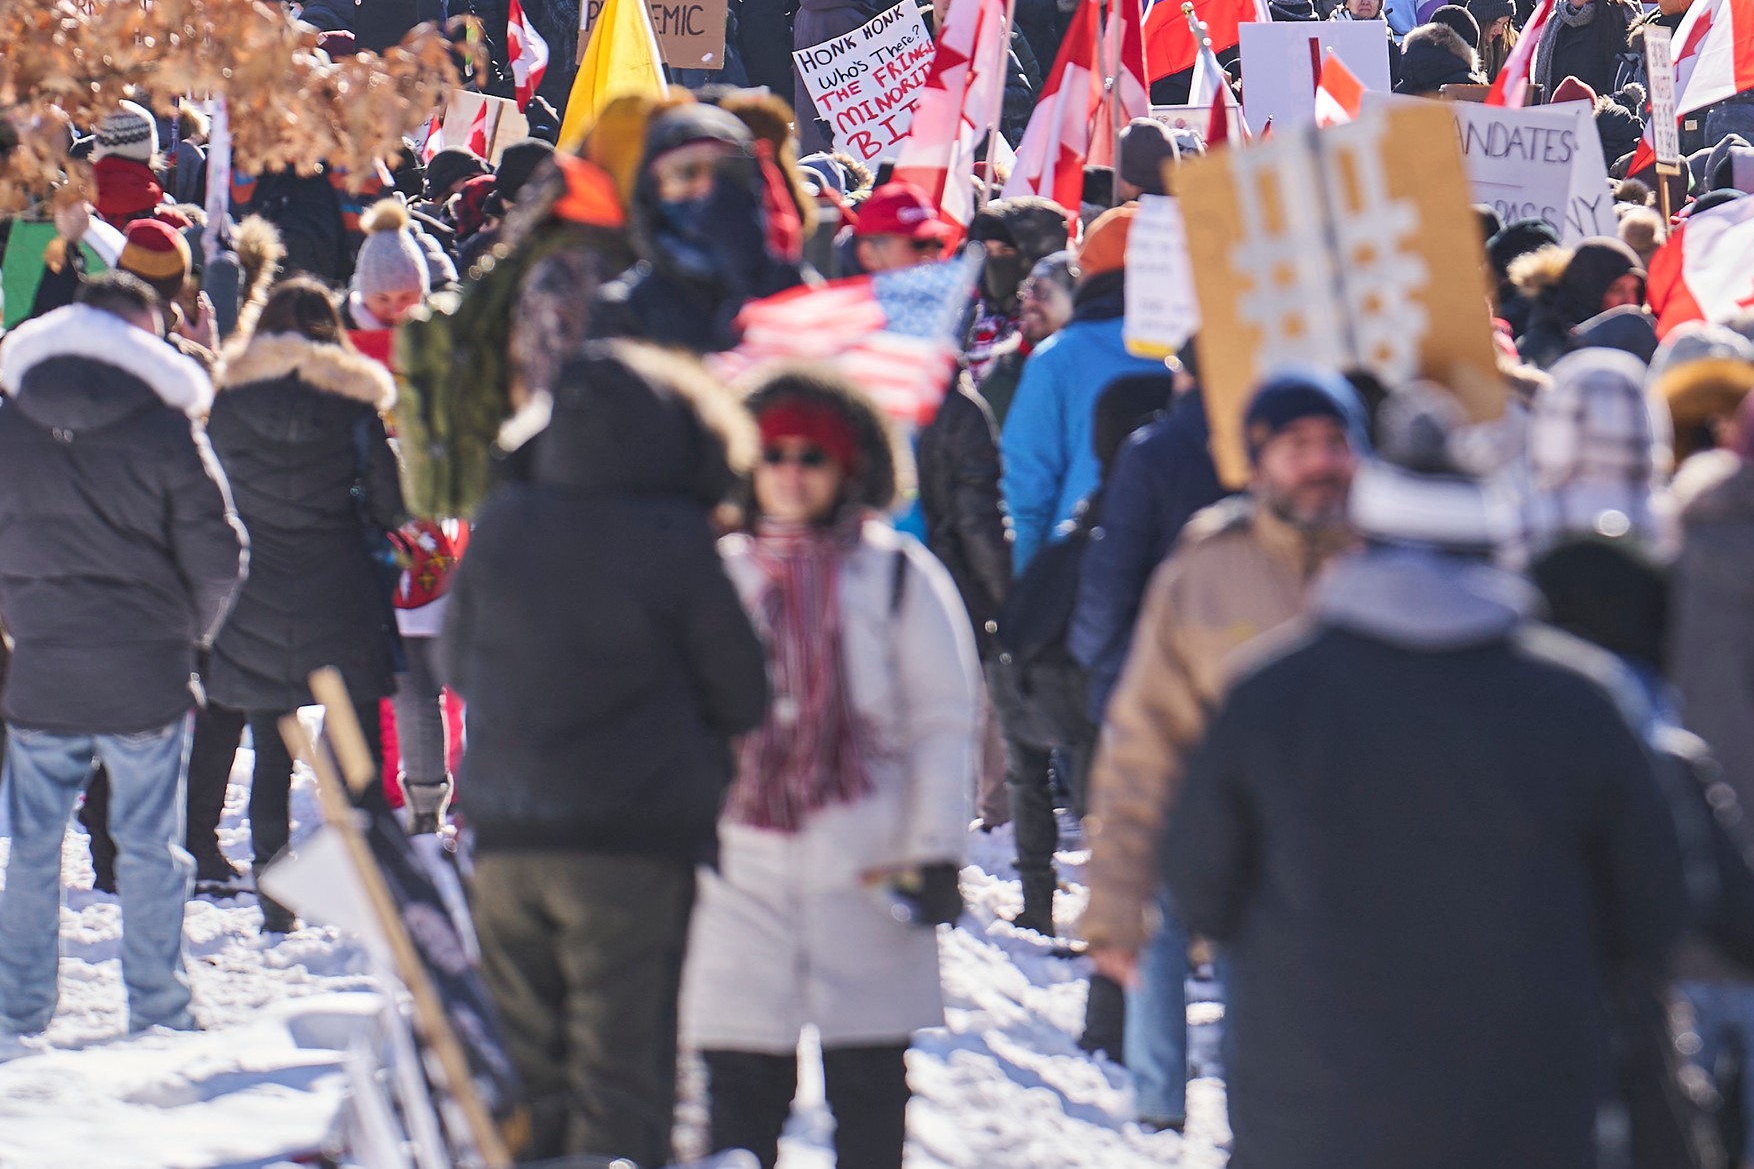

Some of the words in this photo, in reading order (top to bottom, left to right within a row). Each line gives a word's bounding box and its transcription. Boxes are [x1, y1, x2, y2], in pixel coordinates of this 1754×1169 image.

[797, 35, 857, 73] HONK
[862, 5, 905, 41] HONK
[816, 80, 862, 112] THE
[836, 60, 935, 134] MINORIT
[1452, 114, 1574, 163] ANDATES
